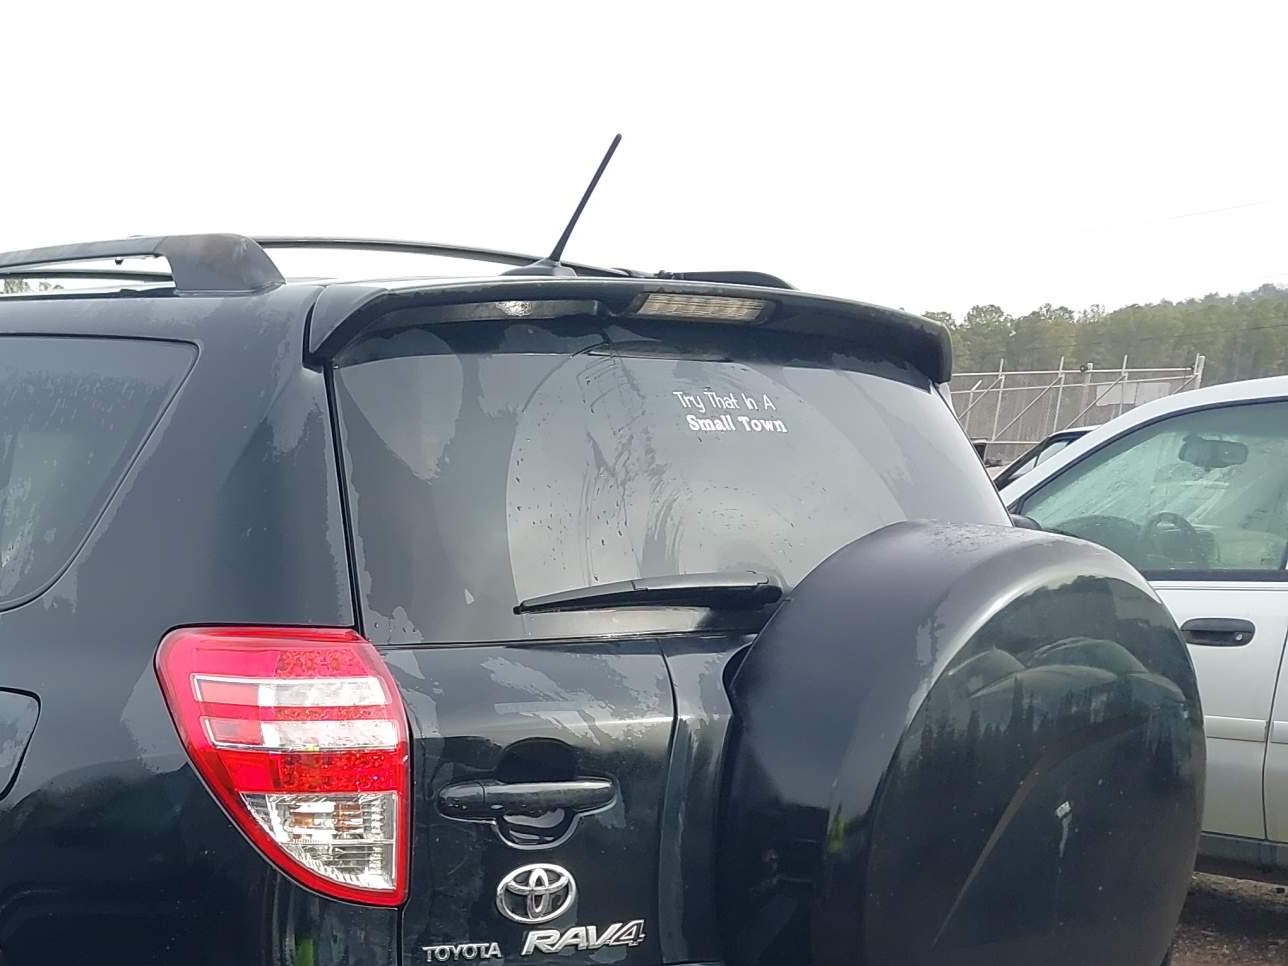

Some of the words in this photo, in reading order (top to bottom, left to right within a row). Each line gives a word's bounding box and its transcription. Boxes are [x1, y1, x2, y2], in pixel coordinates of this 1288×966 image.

[672, 391, 706, 413] Try
[703, 391, 740, 409] That
[741, 392, 758, 410] In
[763, 393, 776, 411] A
[686, 414, 736, 431] Small
[737, 415, 788, 433] Town
[520, 919, 646, 956] RAV4
[422, 942, 503, 962] TOYOTA
